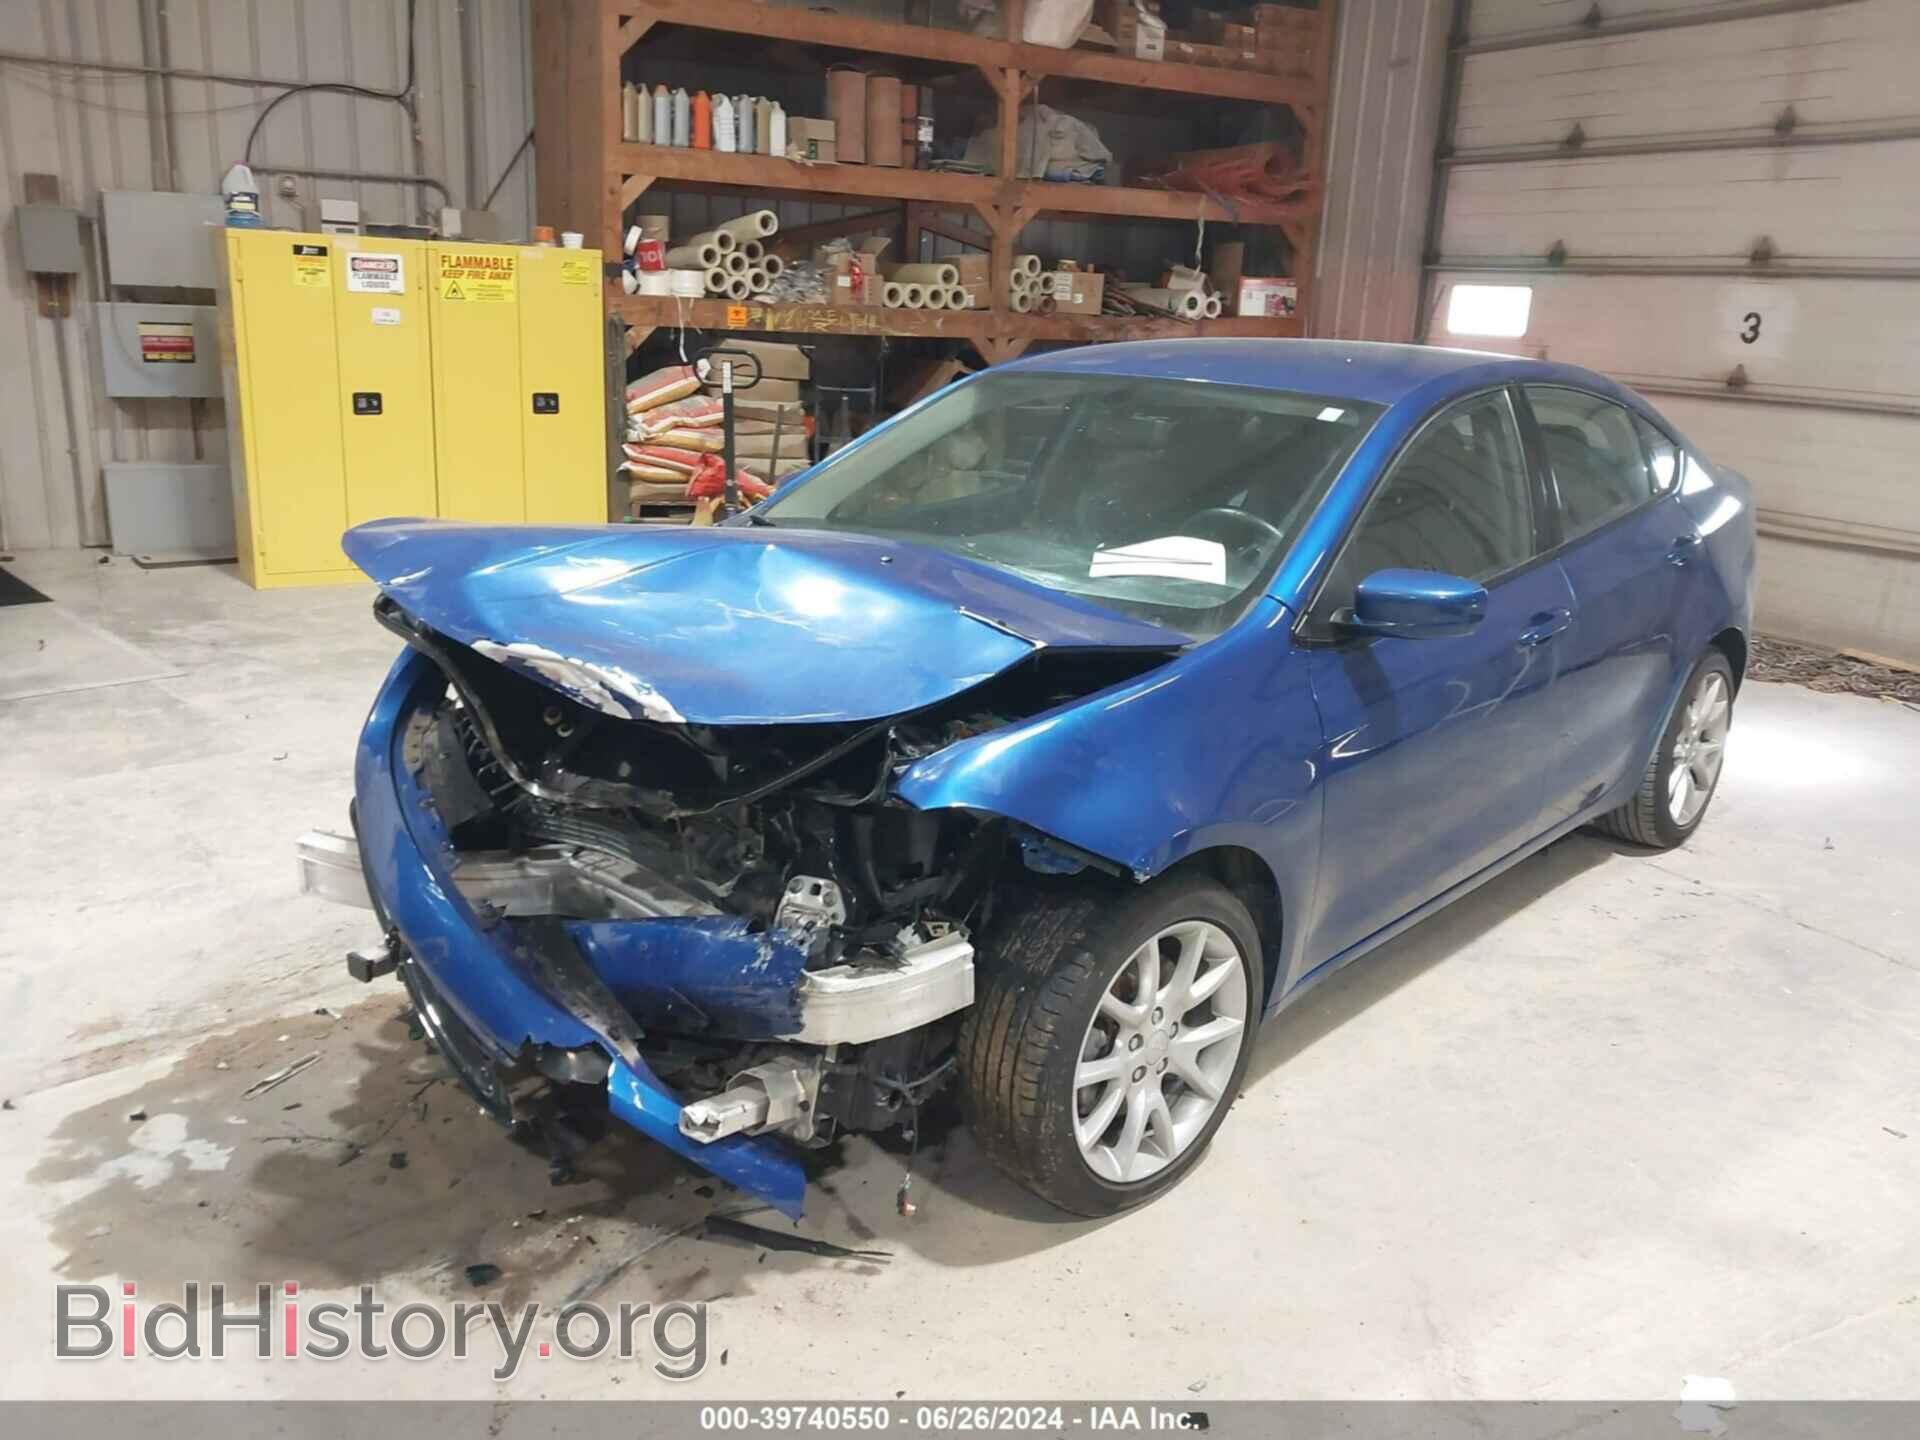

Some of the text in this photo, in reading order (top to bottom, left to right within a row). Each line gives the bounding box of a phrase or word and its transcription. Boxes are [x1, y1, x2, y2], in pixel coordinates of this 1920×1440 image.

[441, 255, 513, 270] FLAMMABLE
[442, 270, 512, 280] KEEP FIRE AWAY
[1740, 312, 1761, 344] 3
